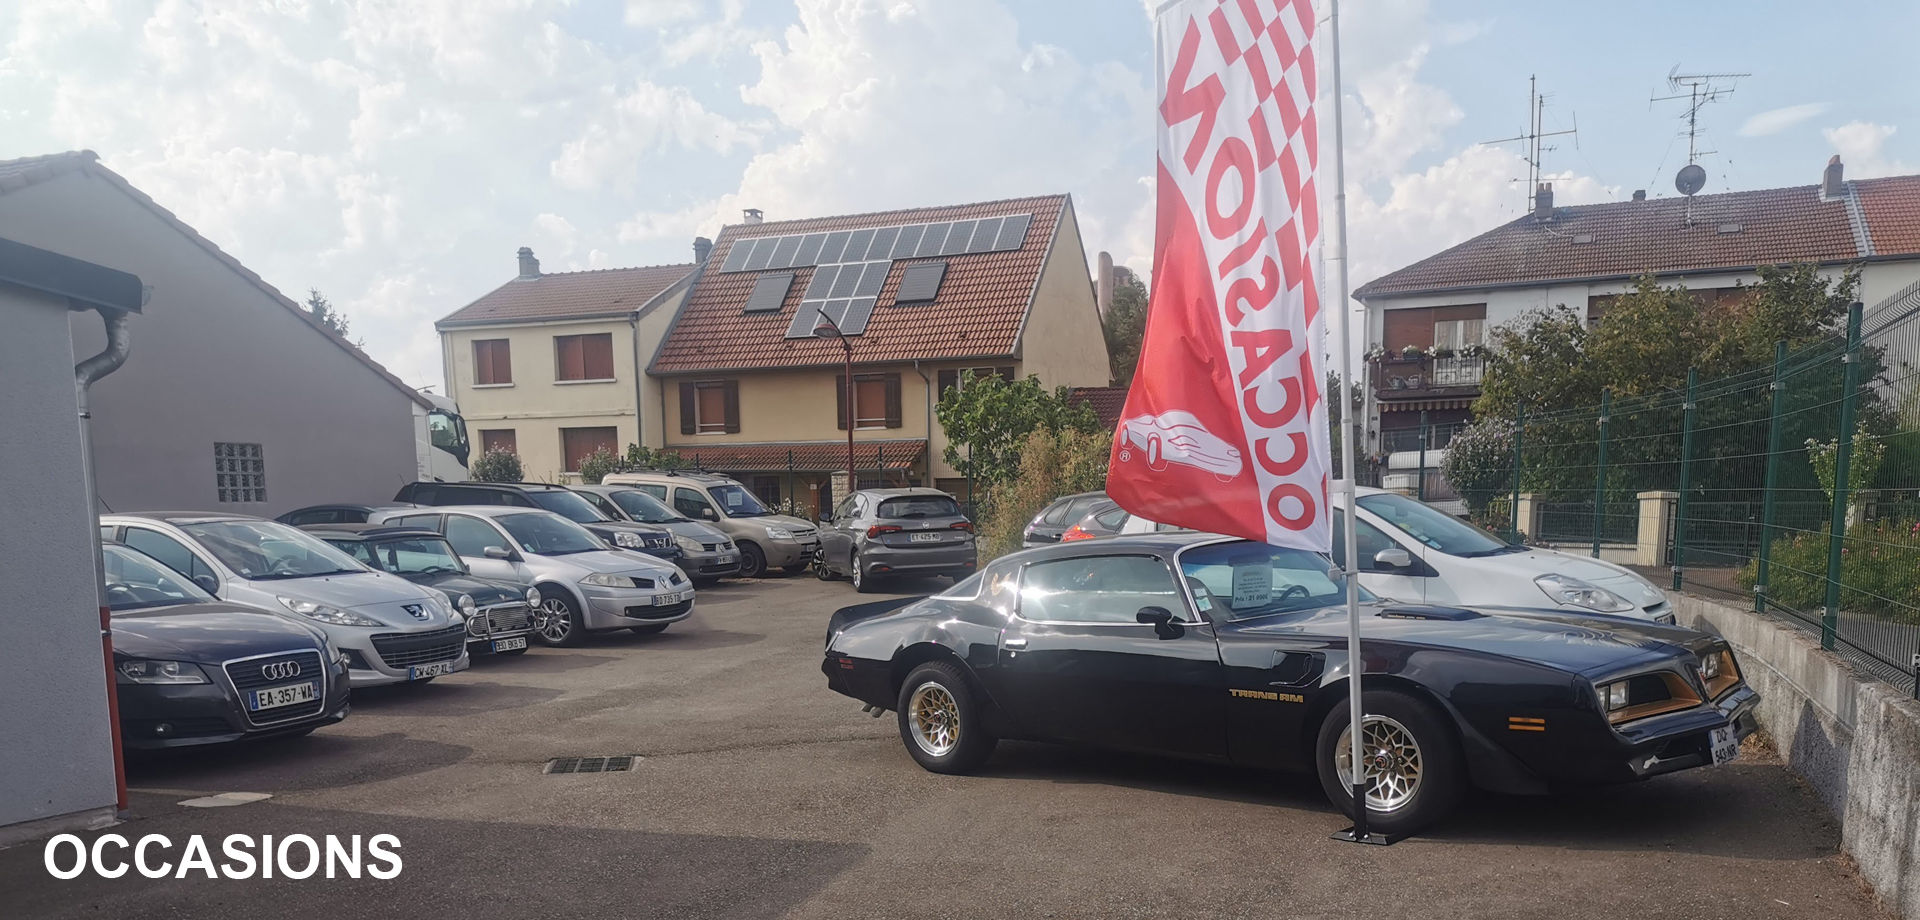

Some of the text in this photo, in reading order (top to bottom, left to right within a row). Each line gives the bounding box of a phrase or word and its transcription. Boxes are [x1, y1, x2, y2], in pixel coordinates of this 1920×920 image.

[259, 684, 313, 707] EA-357-WA
[1229, 689, 1304, 703] TRANS AM
